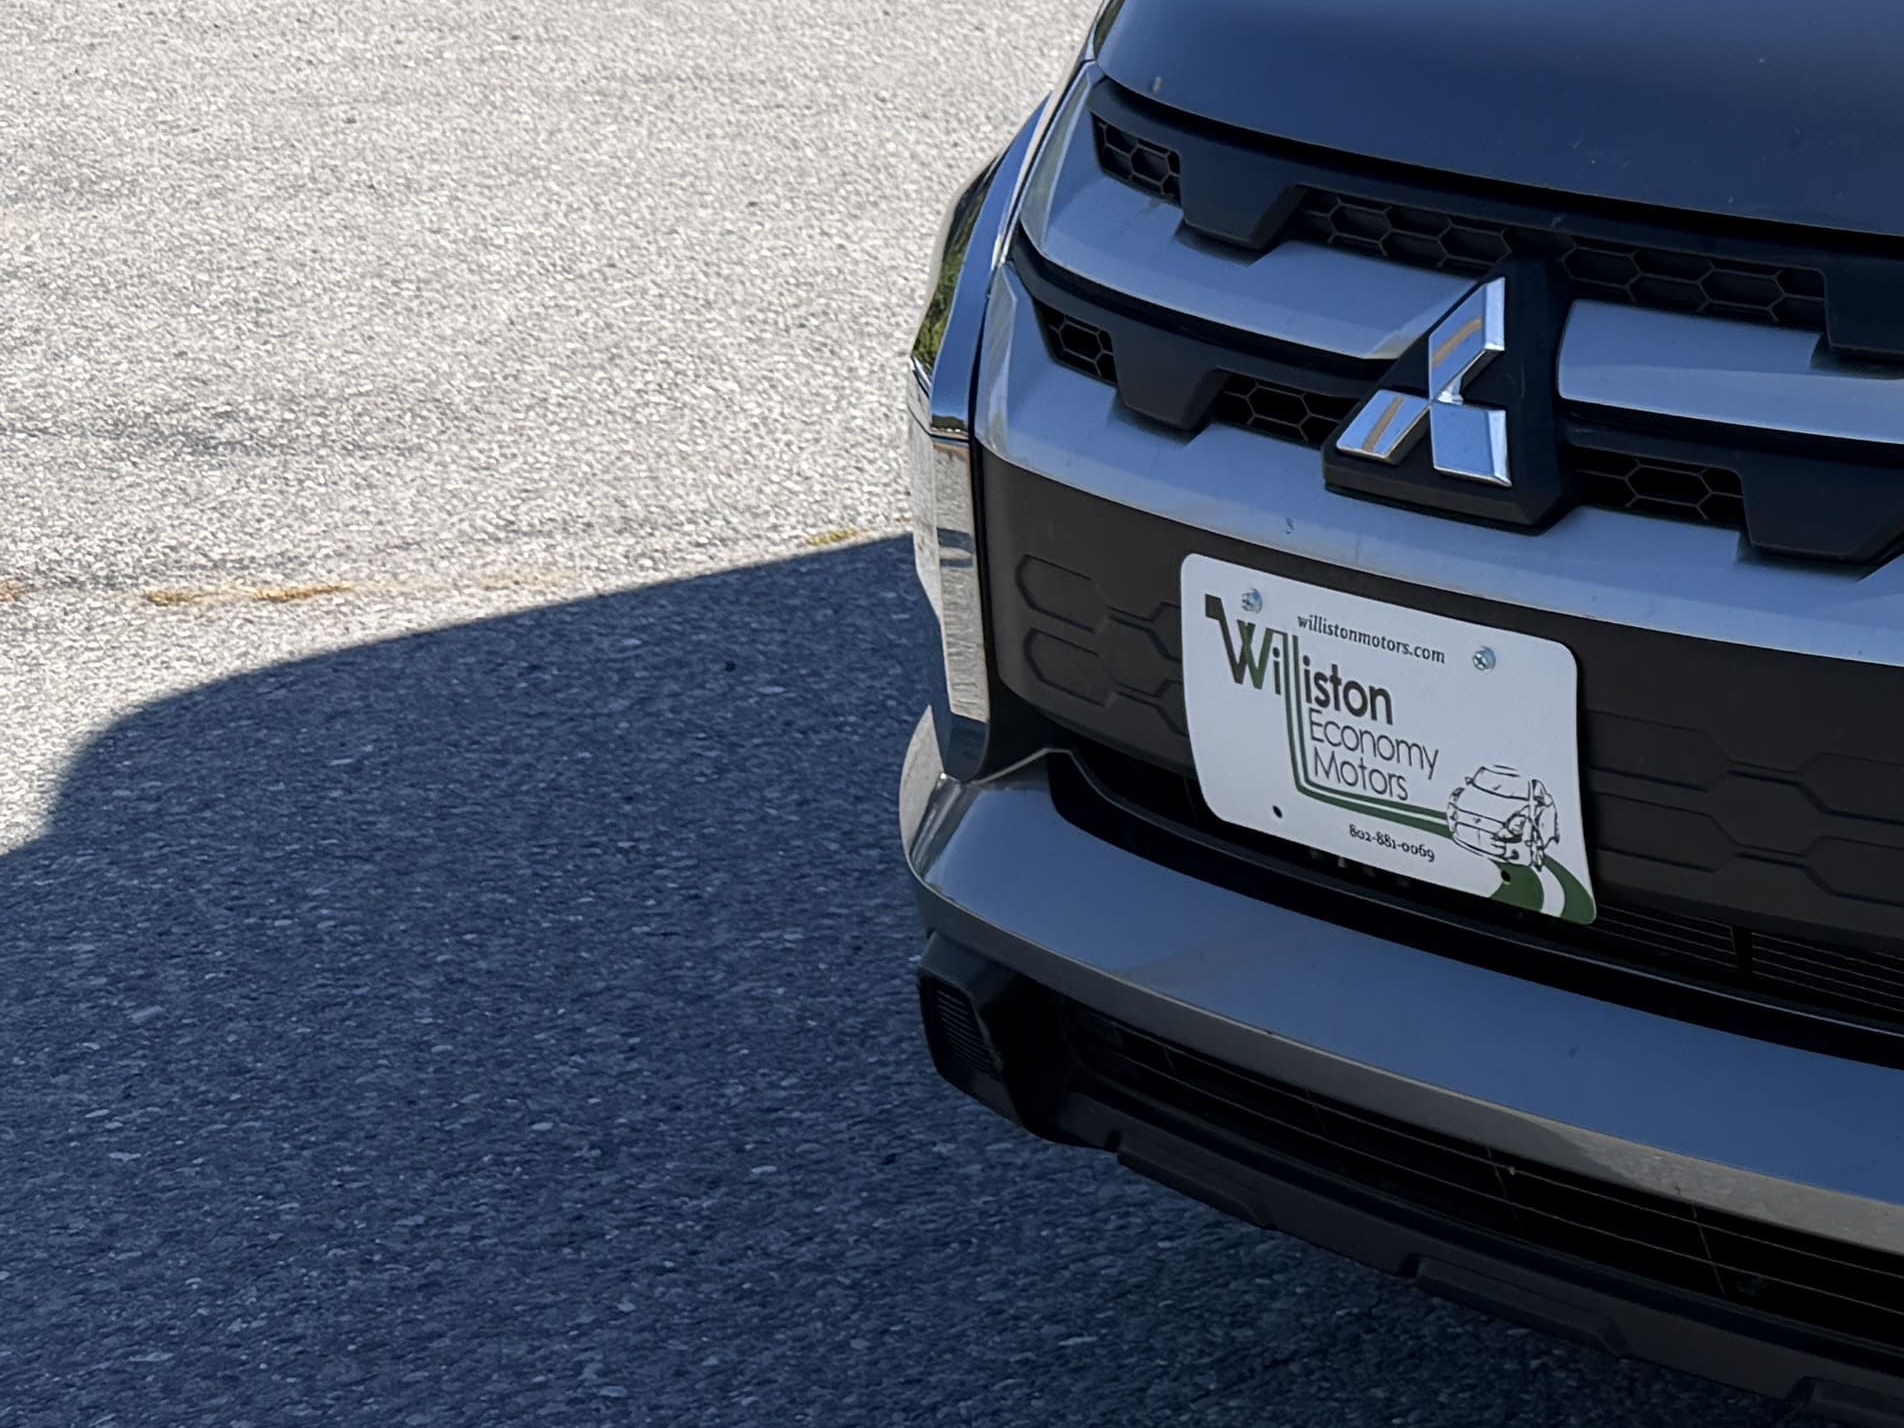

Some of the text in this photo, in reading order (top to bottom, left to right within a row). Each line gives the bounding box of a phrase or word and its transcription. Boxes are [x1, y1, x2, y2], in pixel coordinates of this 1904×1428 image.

[1204, 593, 1393, 725] Williston
[1297, 614, 1446, 664] willistonmotors.com
[1310, 708, 1439, 780] Economy
[1314, 746, 1408, 801] Motors
[1348, 823, 1436, 863] 802-881-0069
